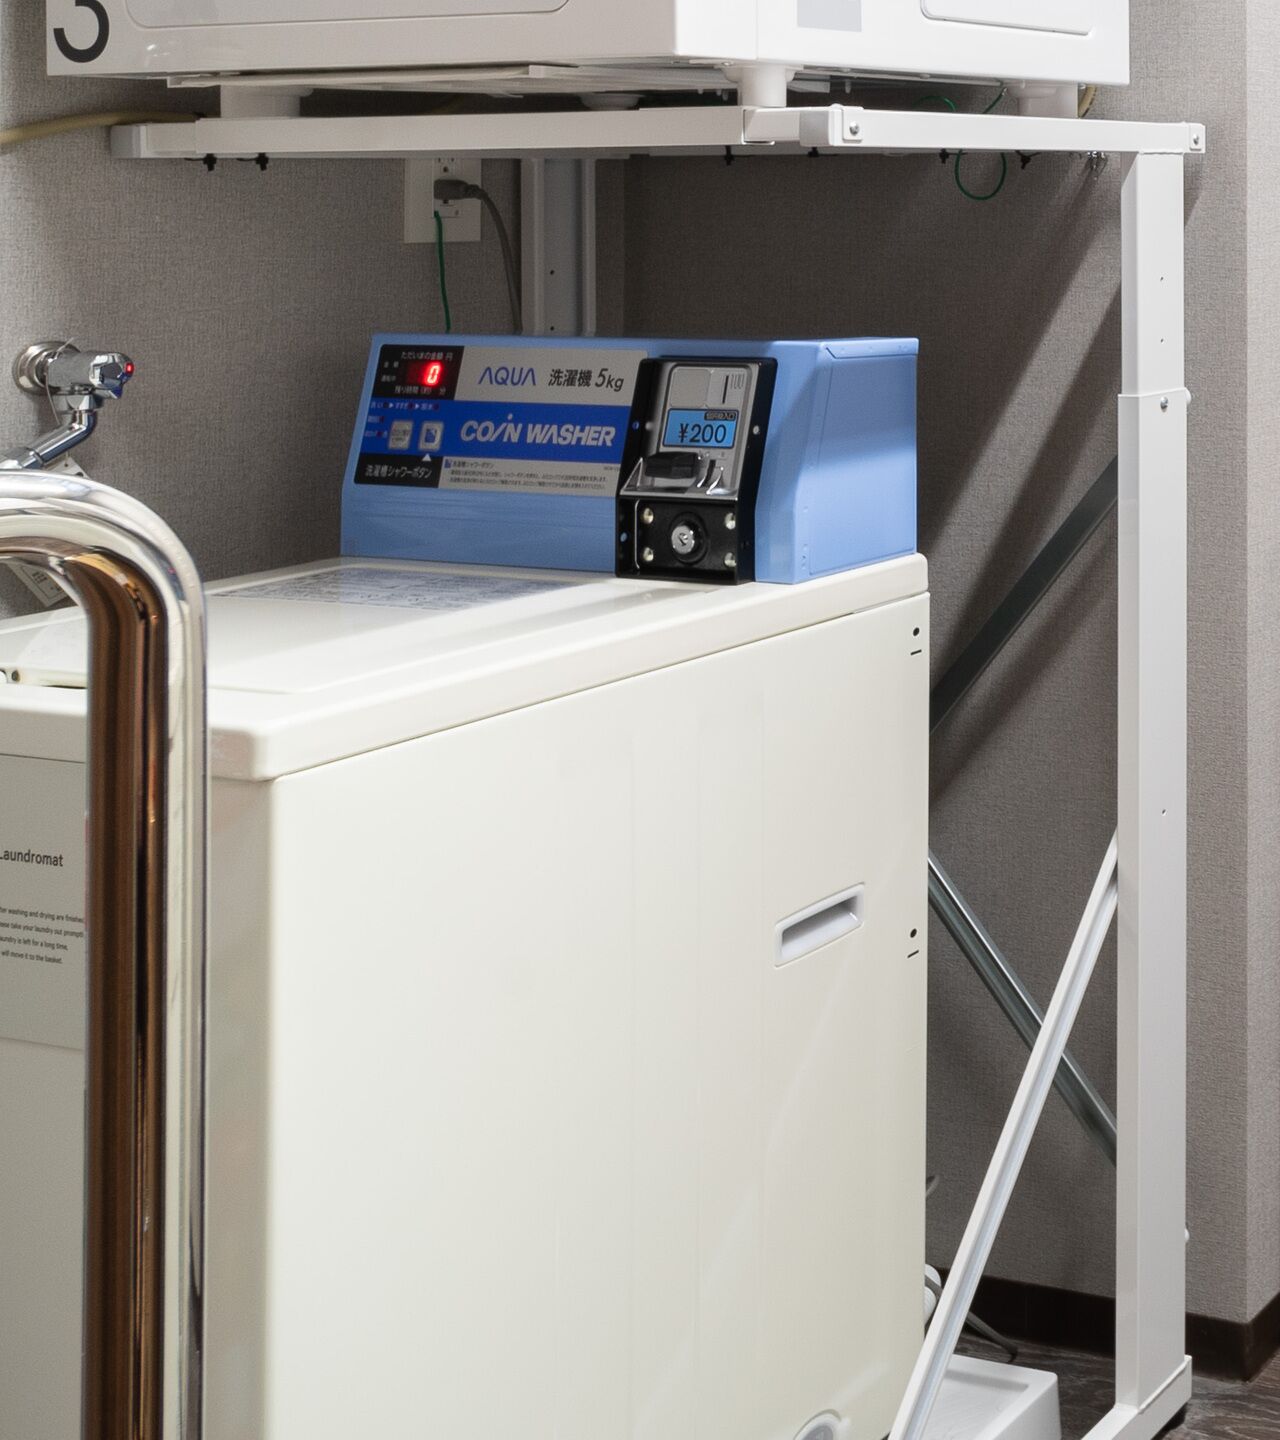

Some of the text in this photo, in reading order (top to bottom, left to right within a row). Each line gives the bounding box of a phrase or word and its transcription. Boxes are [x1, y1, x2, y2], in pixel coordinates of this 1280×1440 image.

[425, 361, 442, 386] 0
[478, 367, 625, 392] AQUA 洗濯機 5kg
[461, 413, 616, 447] COIN WASHER
[678, 422, 727, 444] ¥200
[365, 463, 433, 480] 洗濯槽シャワーボタン
